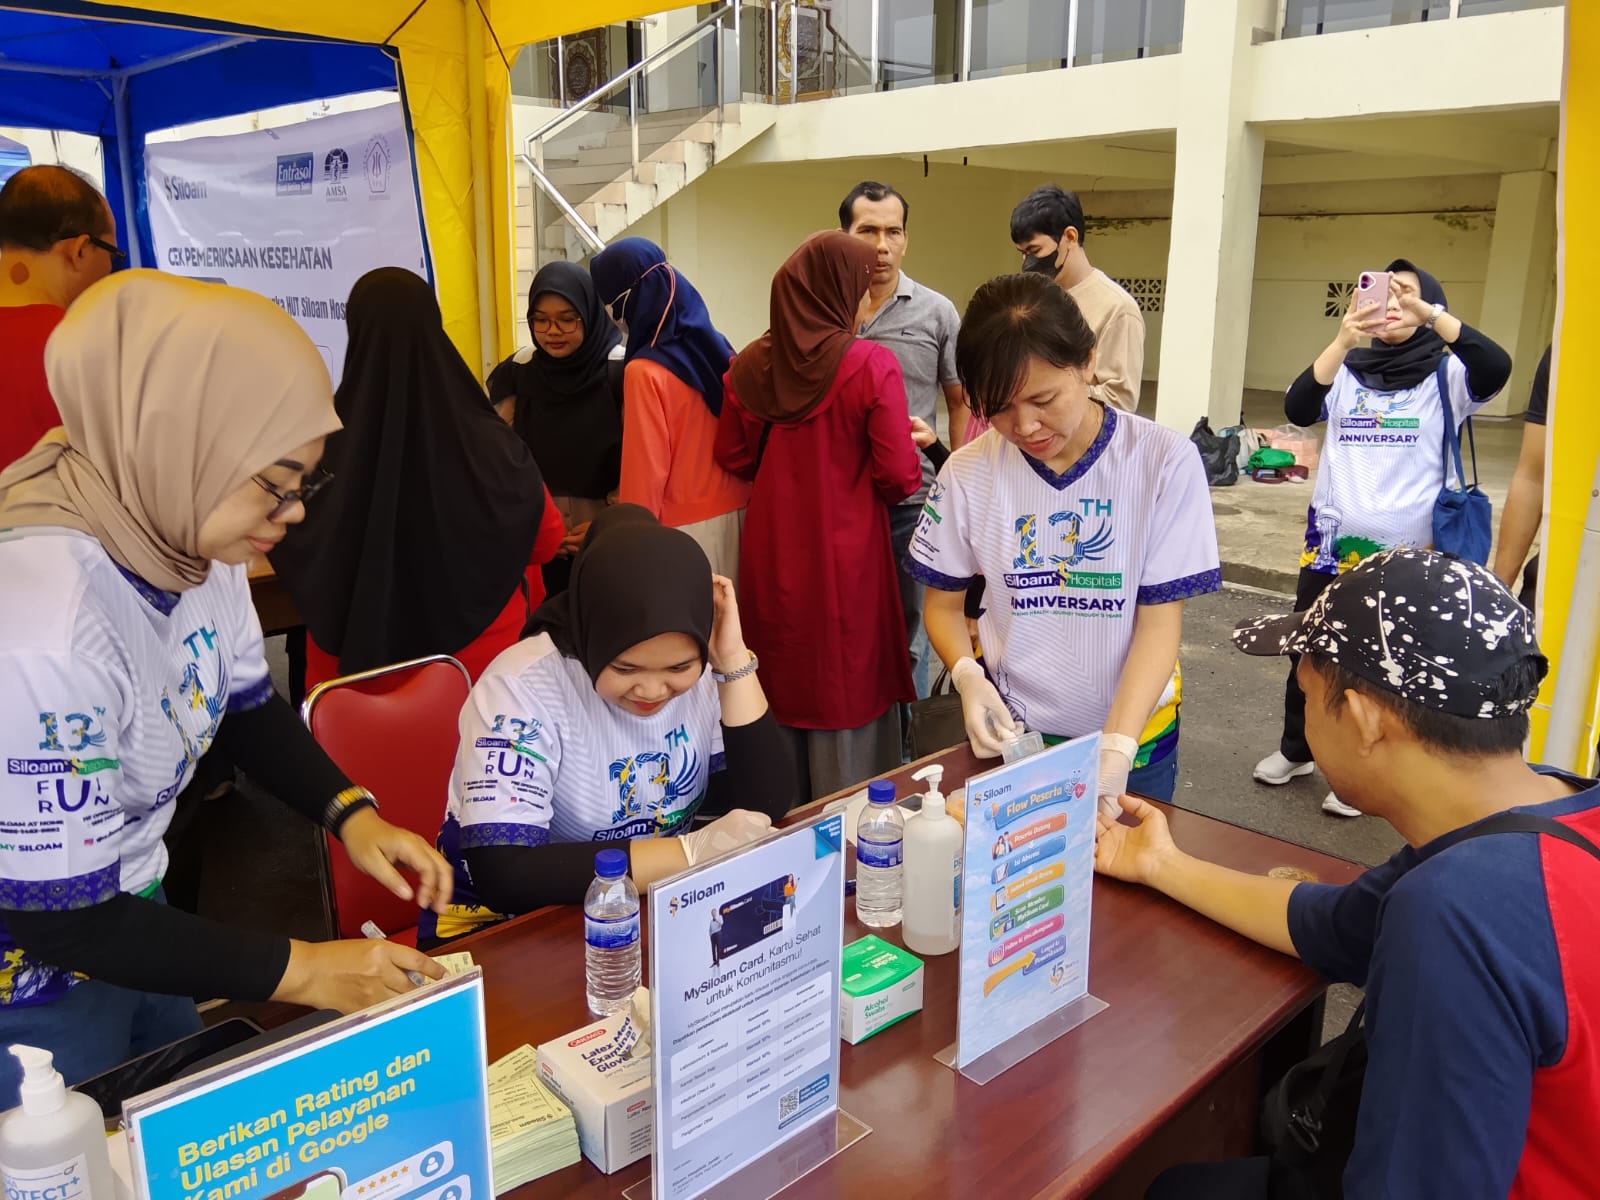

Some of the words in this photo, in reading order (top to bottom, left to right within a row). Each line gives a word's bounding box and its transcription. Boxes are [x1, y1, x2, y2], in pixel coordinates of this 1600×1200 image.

[278, 159, 312, 182] Entrasol
[171, 175, 208, 200] Siloam
[325, 185, 347, 197] AMSA
[167, 247, 184, 266] CEK
[186, 247, 259, 269] PEMERIKSAAN
[261, 247, 333, 270] KESEHATAN
[286, 296, 300, 317] HUT
[301, 296, 328, 319] Siloam
[1341, 418, 1372, 428] Siloam
[1384, 418, 1419, 428] Hospitals
[1338, 434, 1420, 443] ANNIVERSARY
[1005, 574, 1053, 588] Siloam
[1071, 573, 1121, 588] Hospitals
[476, 737, 507, 747] Siloam
[8, 760, 65, 773] Siloam
[983, 784, 1012, 802] Siloam
[1006, 799, 1028, 817] Flow
[1030, 786, 1063, 805] Peserta
[594, 821, 648, 841] Siloam
[18, 842, 63, 852] SILOAM
[680, 881, 725, 910] Siloam
[684, 969, 737, 1002] MySiloam
[769, 939, 794, 959] Kartu
[796, 925, 822, 945] Sehat
[706, 983, 734, 1006] untuk
[736, 948, 803, 990] Komunitasmu!
[864, 995, 889, 1012] Alcohol
[864, 1005, 885, 1018] Swabs
[581, 1043, 614, 1060] Latex
[614, 1016, 631, 1042] Med
[178, 1105, 287, 1168] Berikan
[295, 1070, 379, 1117] Rating
[386, 1047, 431, 1080] dan
[181, 1137, 280, 1191] Ulasan
[287, 1077, 416, 1150] Pelayanan
[265, 1153, 291, 1181] di
[298, 1111, 390, 1164] Google
